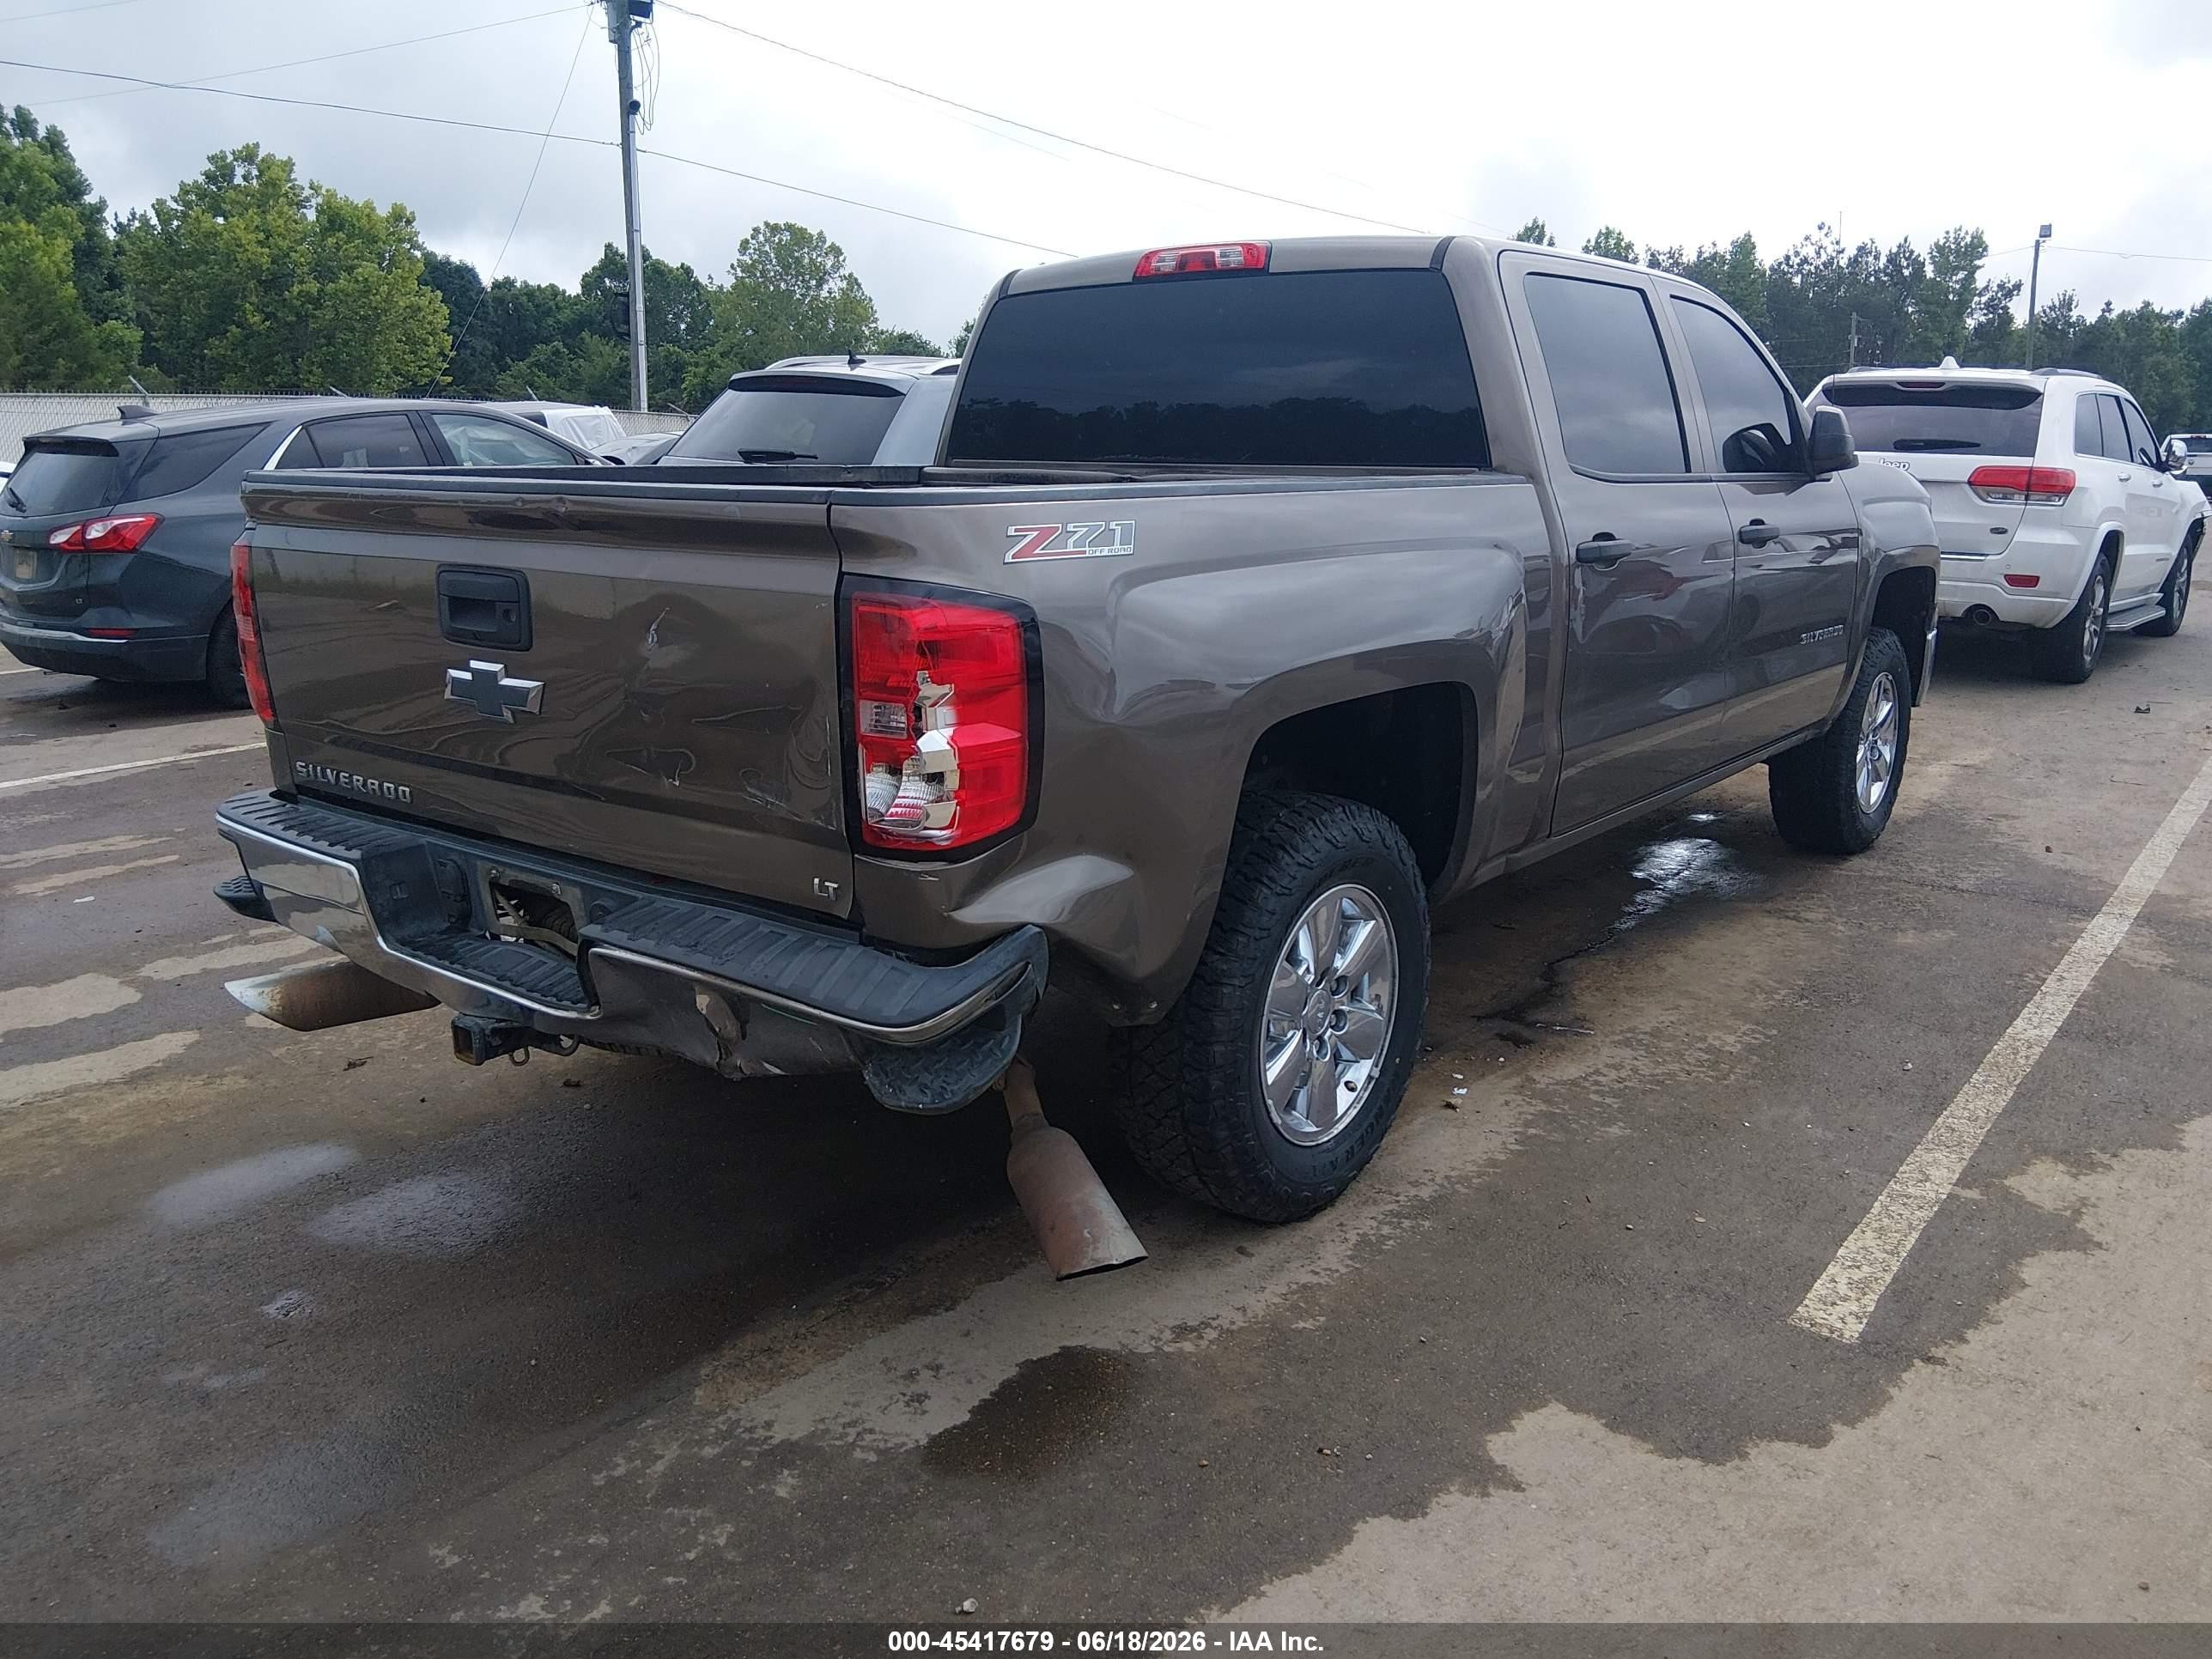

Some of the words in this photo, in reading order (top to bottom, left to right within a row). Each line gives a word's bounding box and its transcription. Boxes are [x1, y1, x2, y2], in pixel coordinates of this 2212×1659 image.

[1004, 520, 1136, 564] Z71
[1107, 545, 1132, 555] ROAD
[295, 761, 411, 804] SILVERADO
[813, 878, 839, 901] LT
